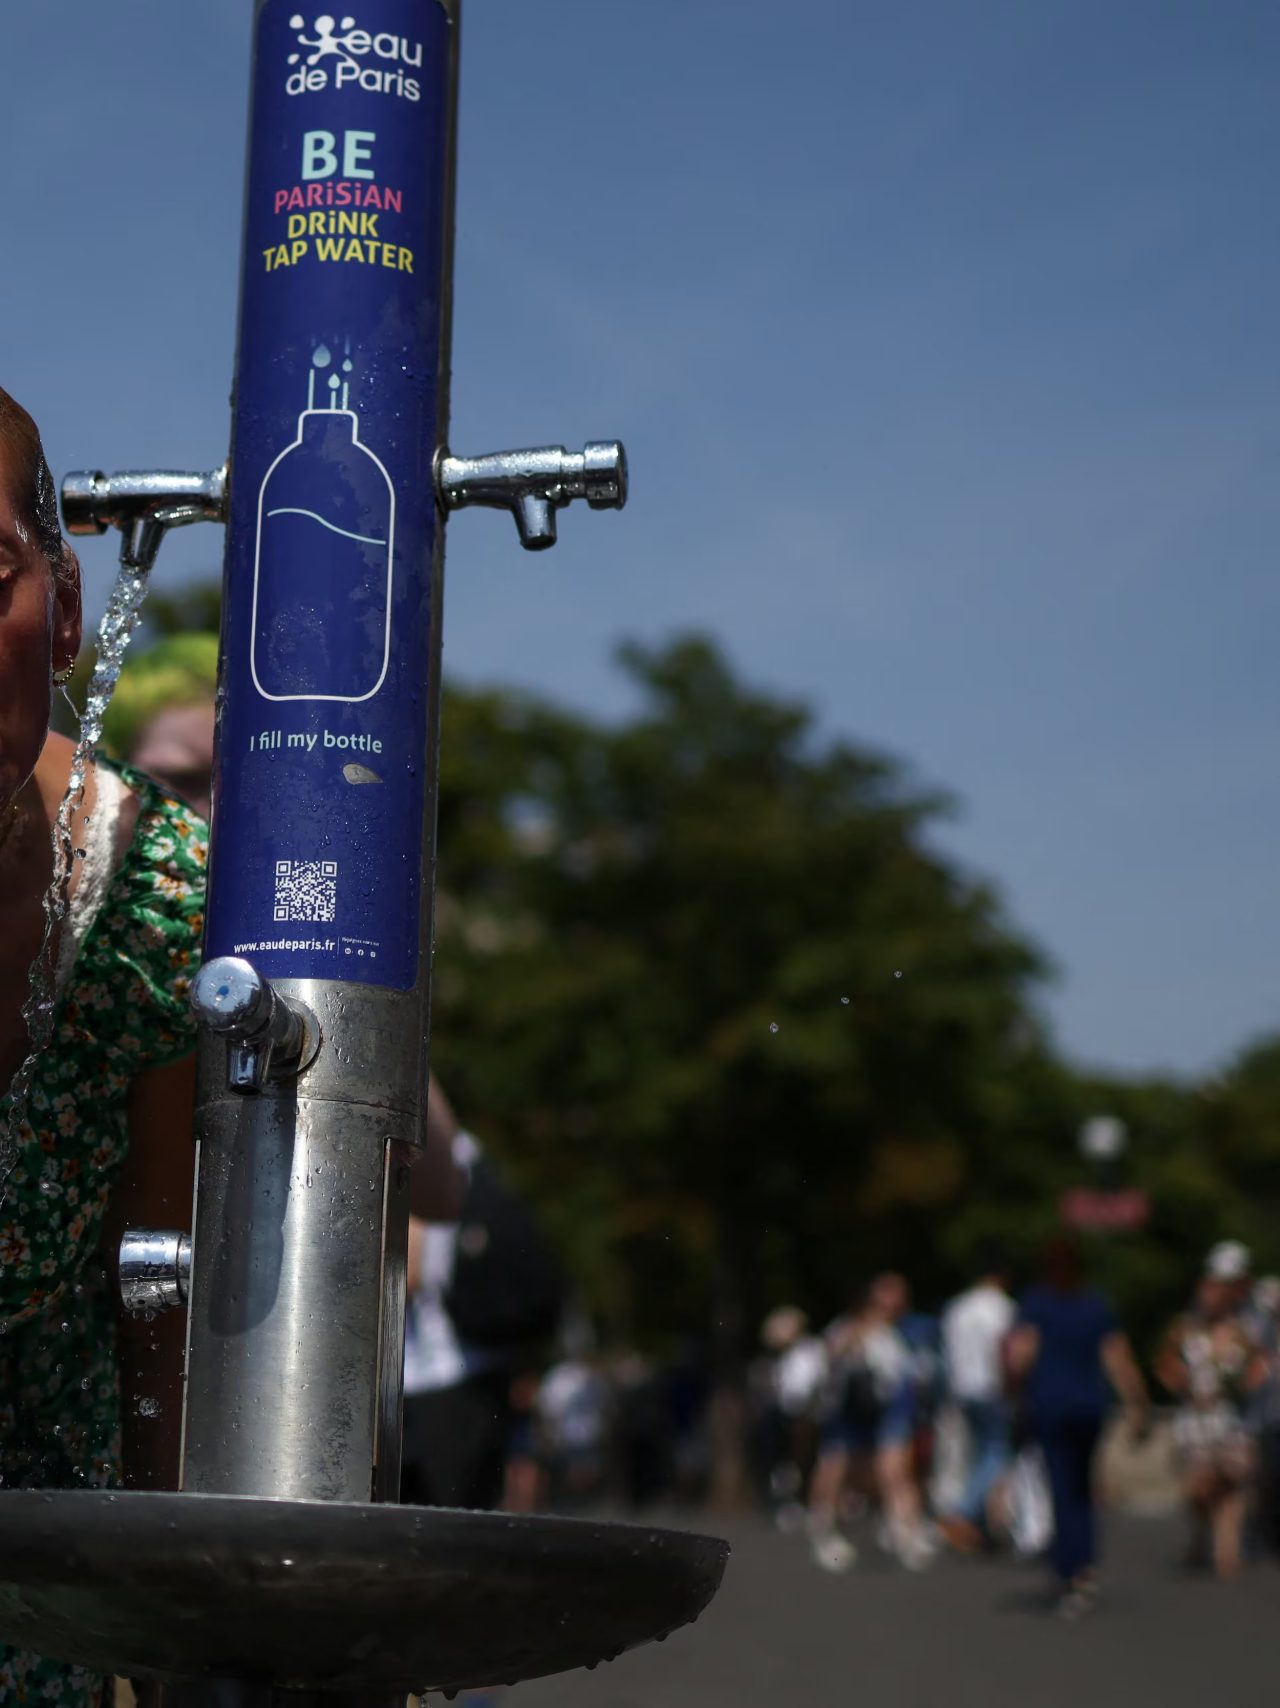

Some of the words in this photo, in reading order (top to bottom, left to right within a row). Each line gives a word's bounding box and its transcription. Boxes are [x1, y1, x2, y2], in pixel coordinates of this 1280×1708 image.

[343, 30, 422, 67] eau
[285, 65, 328, 96] de
[335, 62, 421, 102] Paris
[302, 130, 376, 180] BE
[263, 240, 308, 272] TAP
[315, 238, 414, 274] WATER
[250, 735, 255, 752] I
[259, 730, 282, 750] fill
[287, 733, 318, 752] my
[323, 729, 383, 754] bottle
[234, 938, 335, 954] www.eaudeparis.fr
